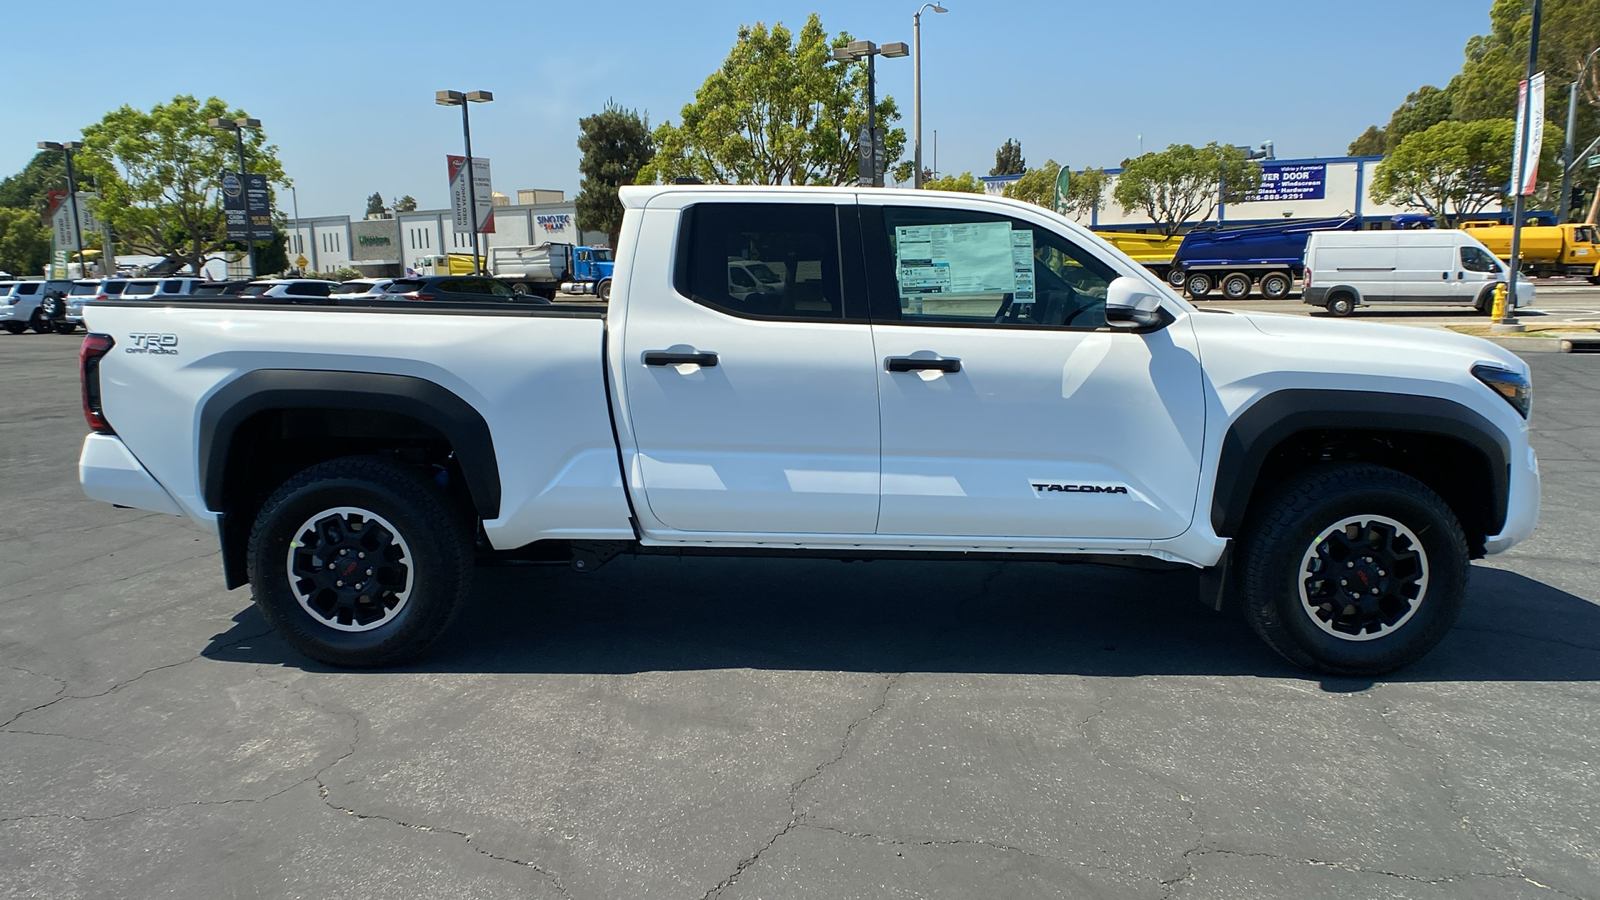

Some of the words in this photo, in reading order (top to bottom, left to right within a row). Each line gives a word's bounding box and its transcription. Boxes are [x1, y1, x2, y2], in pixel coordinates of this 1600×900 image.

[1282, 172, 1310, 180] DOOR
[987, 181, 1008, 189] 1710
[63, 204, 71, 232] VEHICLES
[537, 214, 570, 224] SINOTEC
[58, 217, 66, 246] CERTIFIED
[129, 333, 178, 350] TRD
[1031, 484, 1128, 494] TACOMA
